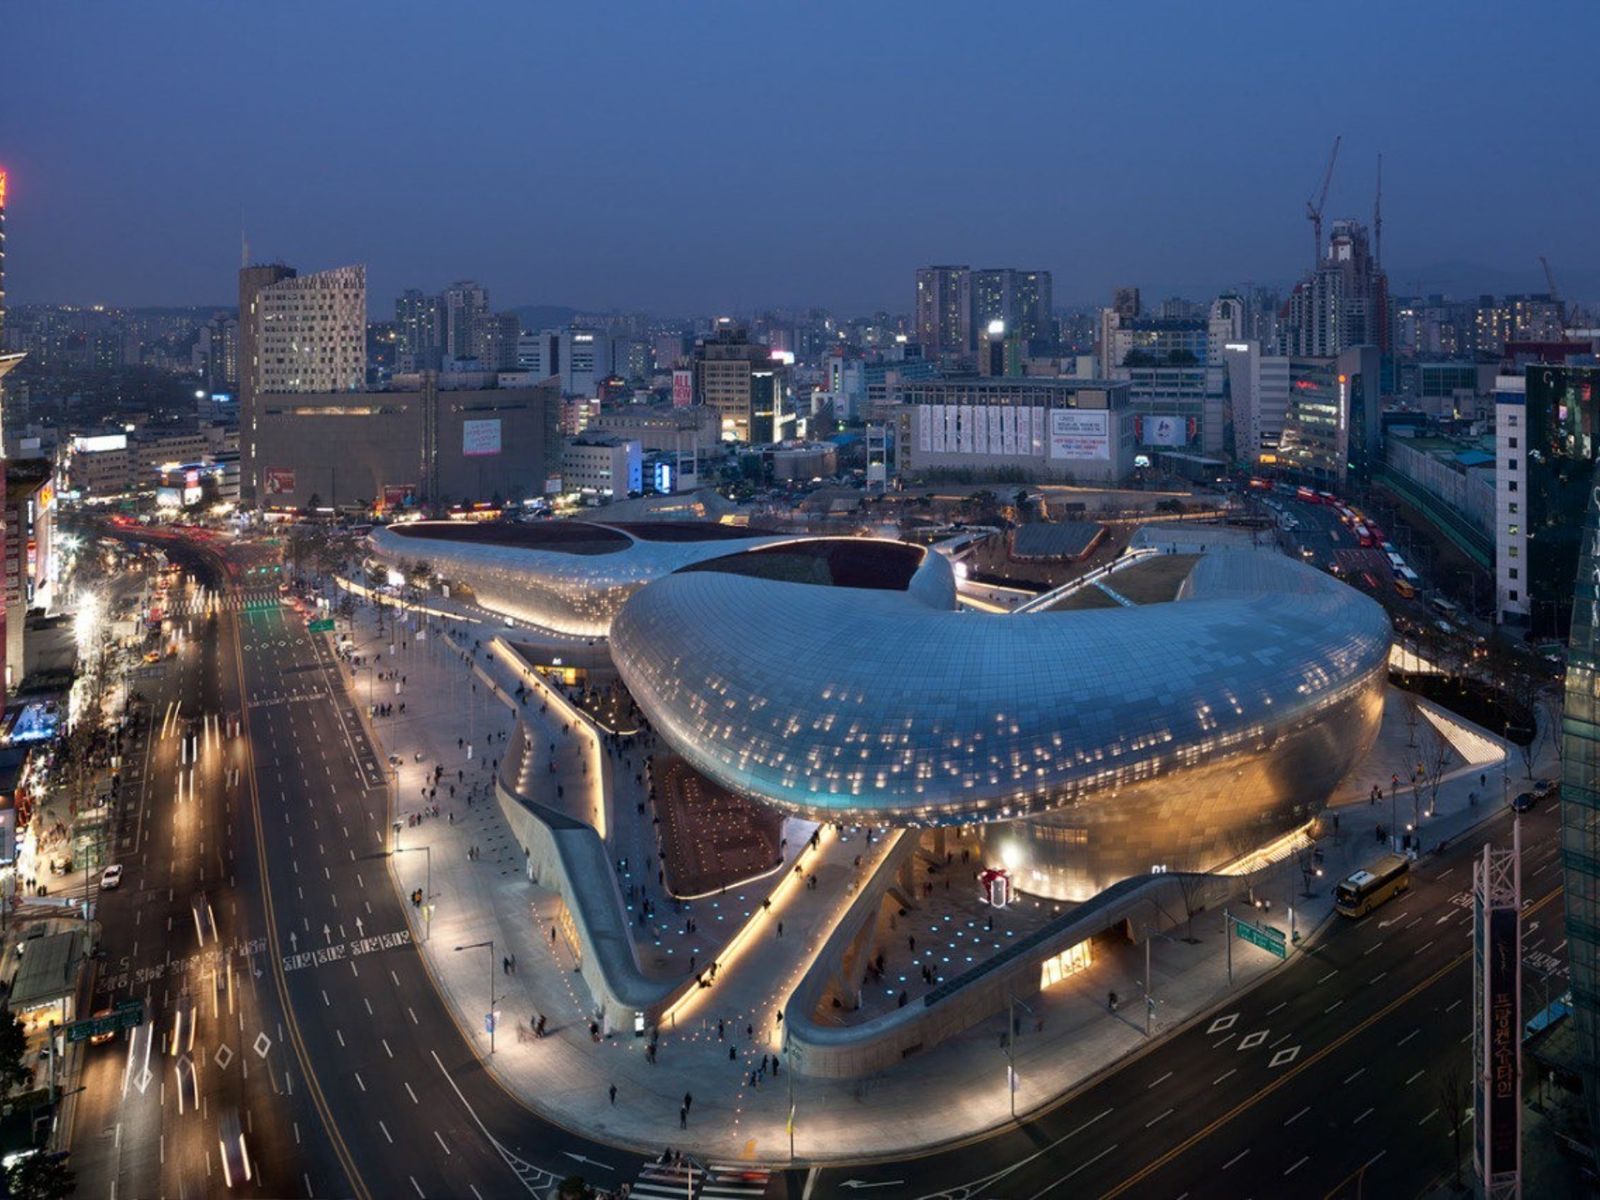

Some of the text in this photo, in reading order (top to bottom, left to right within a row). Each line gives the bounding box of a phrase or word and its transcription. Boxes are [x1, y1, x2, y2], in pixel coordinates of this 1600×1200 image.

[282, 930, 412, 972] 동대문 동대문 동대문 동대문
[1493, 993, 1513, 1098] 프랑켄슈타인
